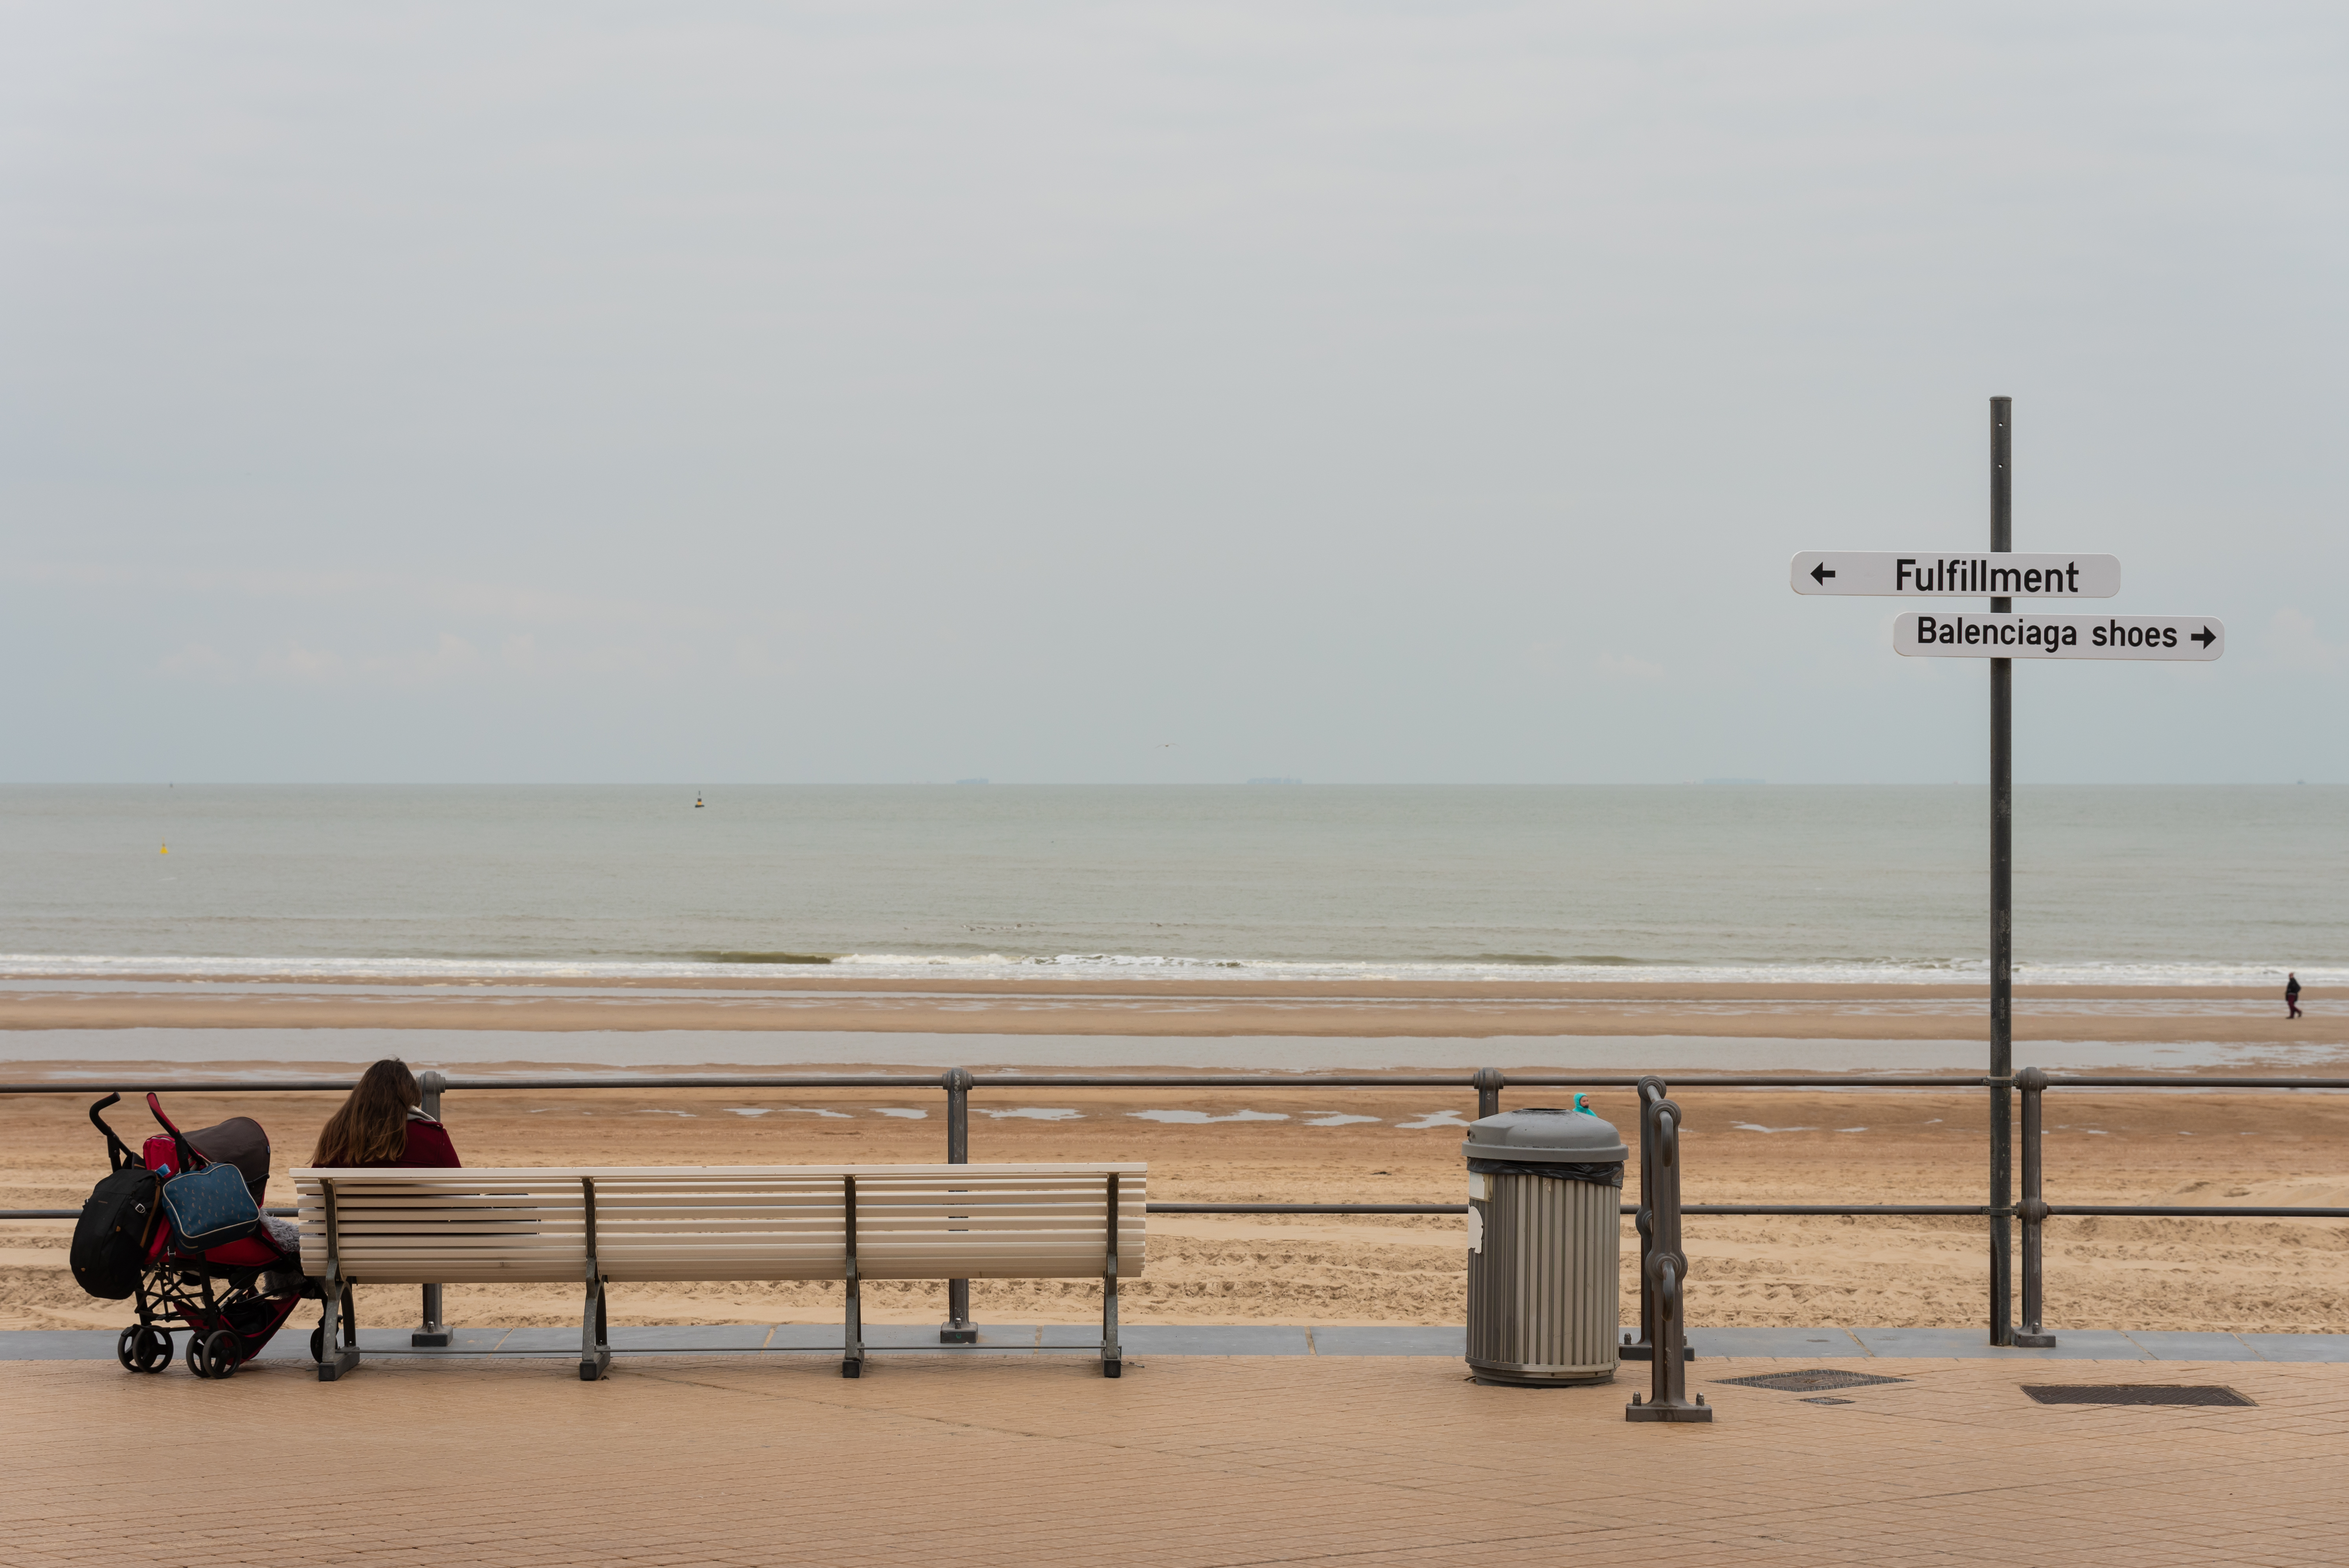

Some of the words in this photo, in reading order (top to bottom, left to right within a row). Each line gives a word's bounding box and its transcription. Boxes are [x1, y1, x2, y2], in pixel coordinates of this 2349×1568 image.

[1897, 559, 2079, 593] Fulfillment
[1918, 616, 2077, 653] Balenciaga
[2092, 619, 2177, 648] shoes
